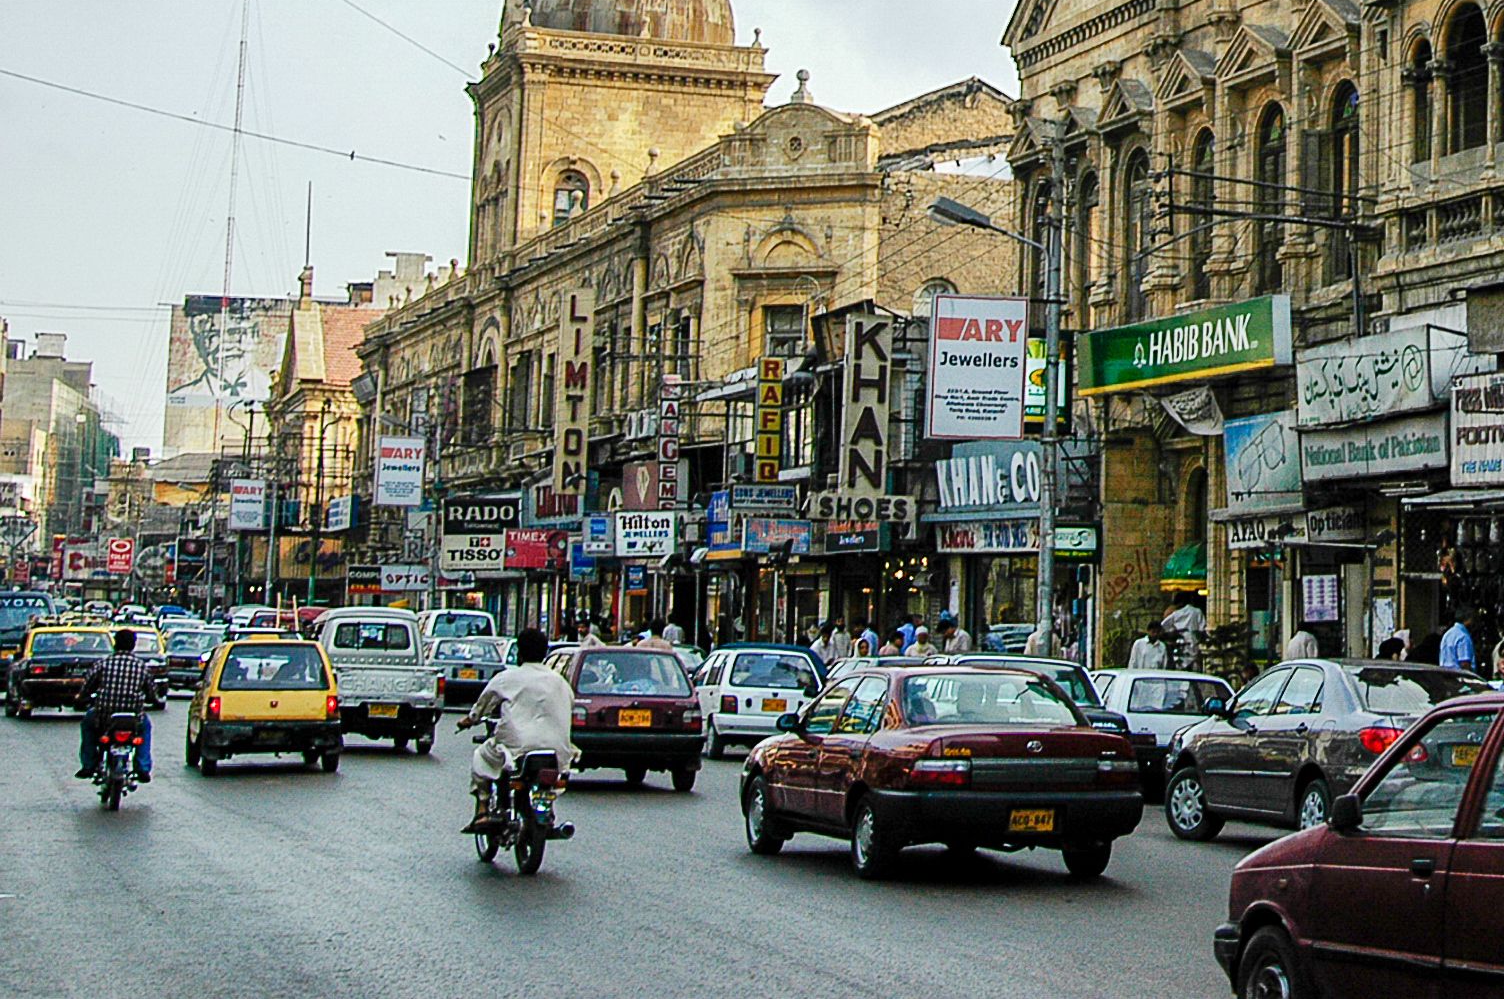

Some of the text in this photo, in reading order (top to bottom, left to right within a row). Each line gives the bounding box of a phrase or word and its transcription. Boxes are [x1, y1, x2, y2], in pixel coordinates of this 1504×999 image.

[962, 319, 1024, 342] ARY
[1149, 313, 1252, 367] HABIB BANK
[940, 351, 1019, 368] Jewellers
[562, 294, 588, 491] LIMTON
[848, 321, 889, 490] KHAN
[760, 360, 780, 480] RAFIQ
[393, 447, 424, 461] ARY
[1304, 432, 1441, 468] National Bank of Pakistan
[936, 454, 995, 508] KHAN
[449, 506, 514, 521] RADO
[819, 495, 908, 521] SHOES
[619, 514, 670, 530] Hilton
[508, 531, 548, 542] TIMEX
